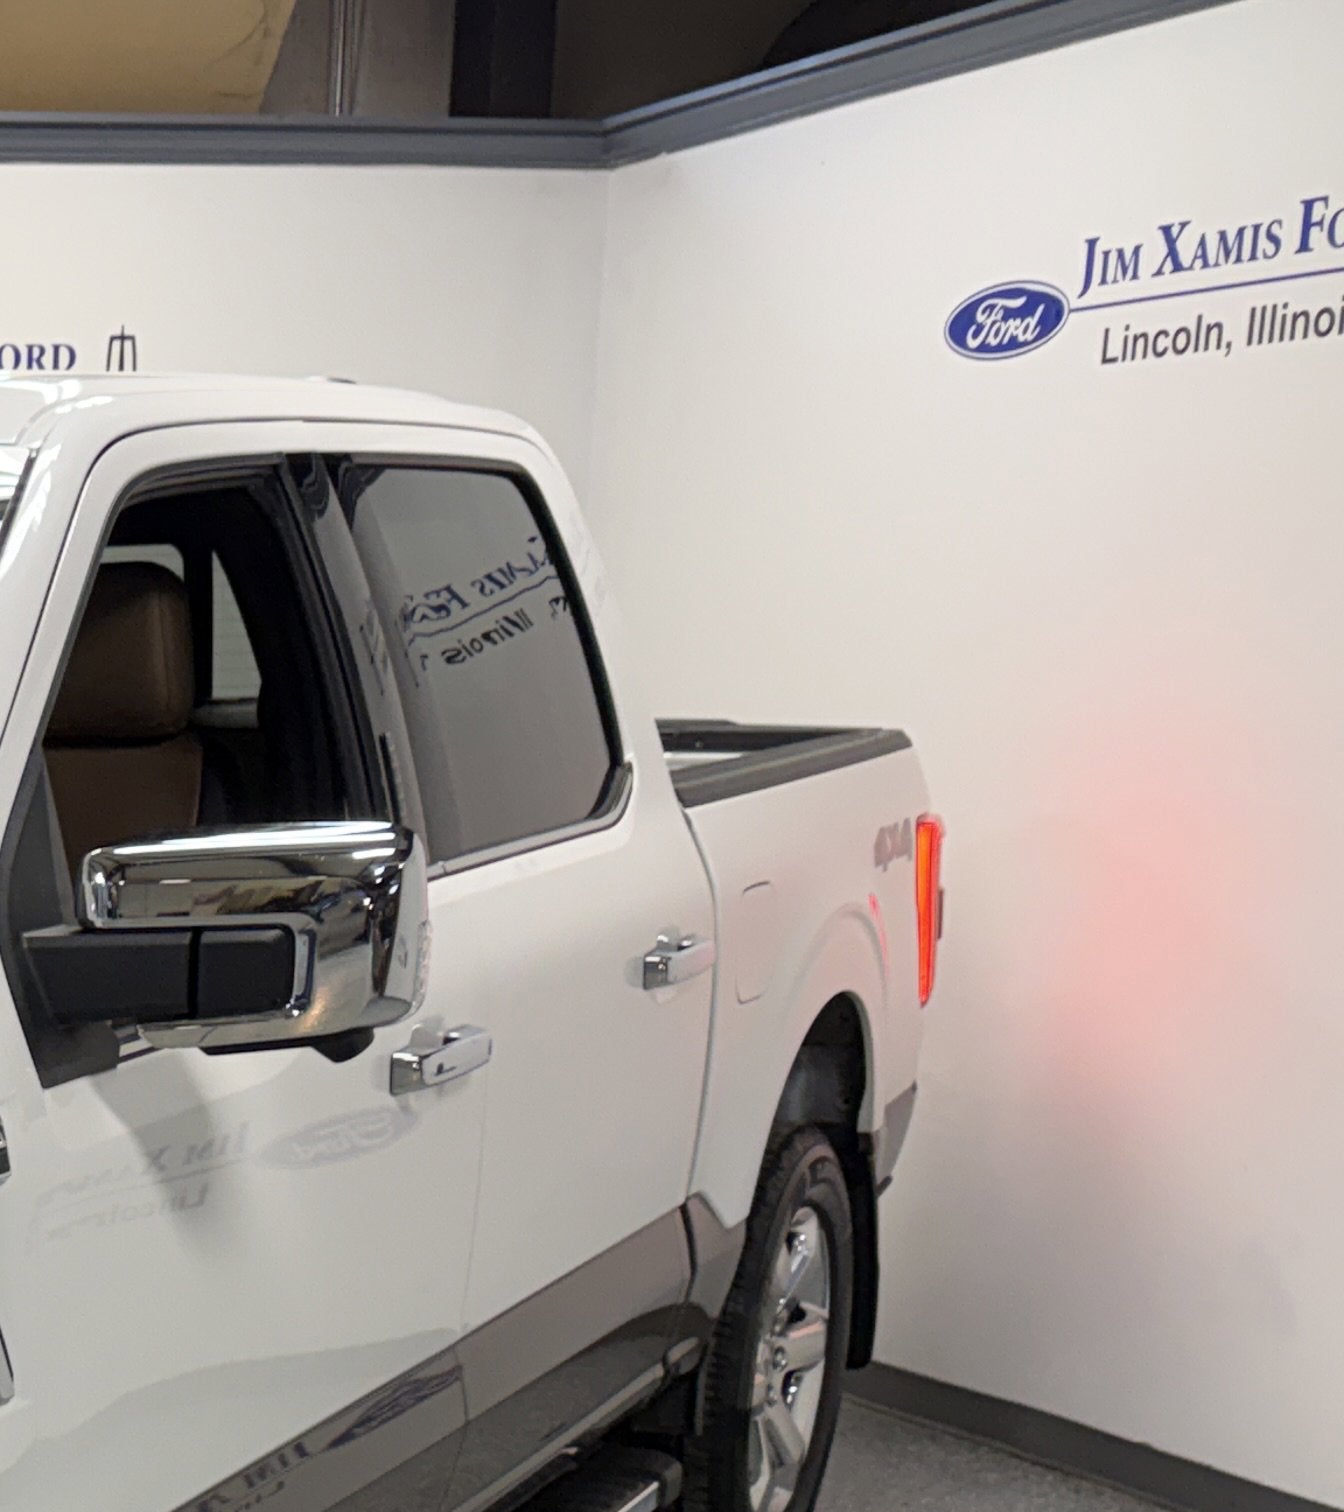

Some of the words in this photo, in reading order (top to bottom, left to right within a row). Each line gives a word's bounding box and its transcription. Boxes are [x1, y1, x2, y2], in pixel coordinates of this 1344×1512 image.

[1077, 236, 1144, 299] JIM
[1151, 219, 1283, 277] XAMIS
[966, 295, 1045, 349] Ford
[1100, 314, 1233, 366] Lincoln,
